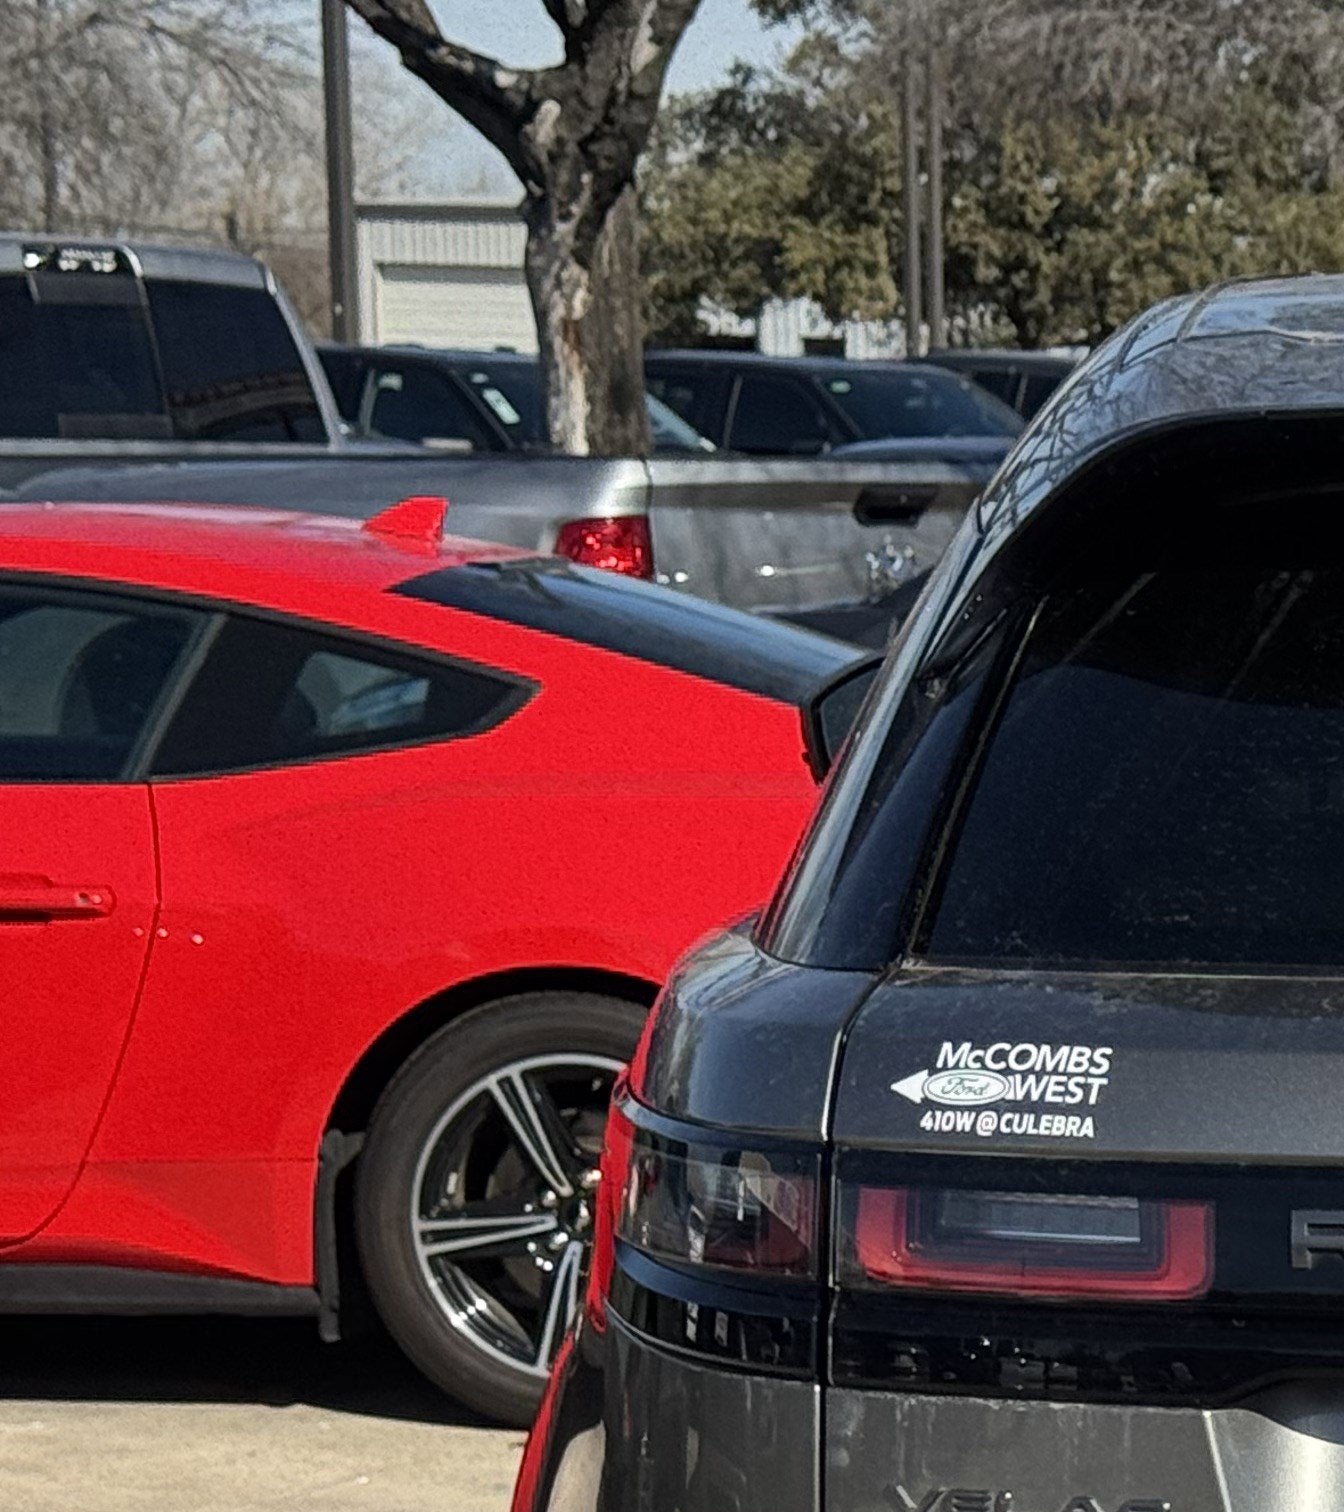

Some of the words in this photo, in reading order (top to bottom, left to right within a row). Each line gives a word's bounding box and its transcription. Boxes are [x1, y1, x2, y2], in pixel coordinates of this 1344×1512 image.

[936, 1042, 1113, 1075] McCOMBS
[940, 1076, 990, 1097] Ford
[1014, 1074, 1108, 1105] WEST
